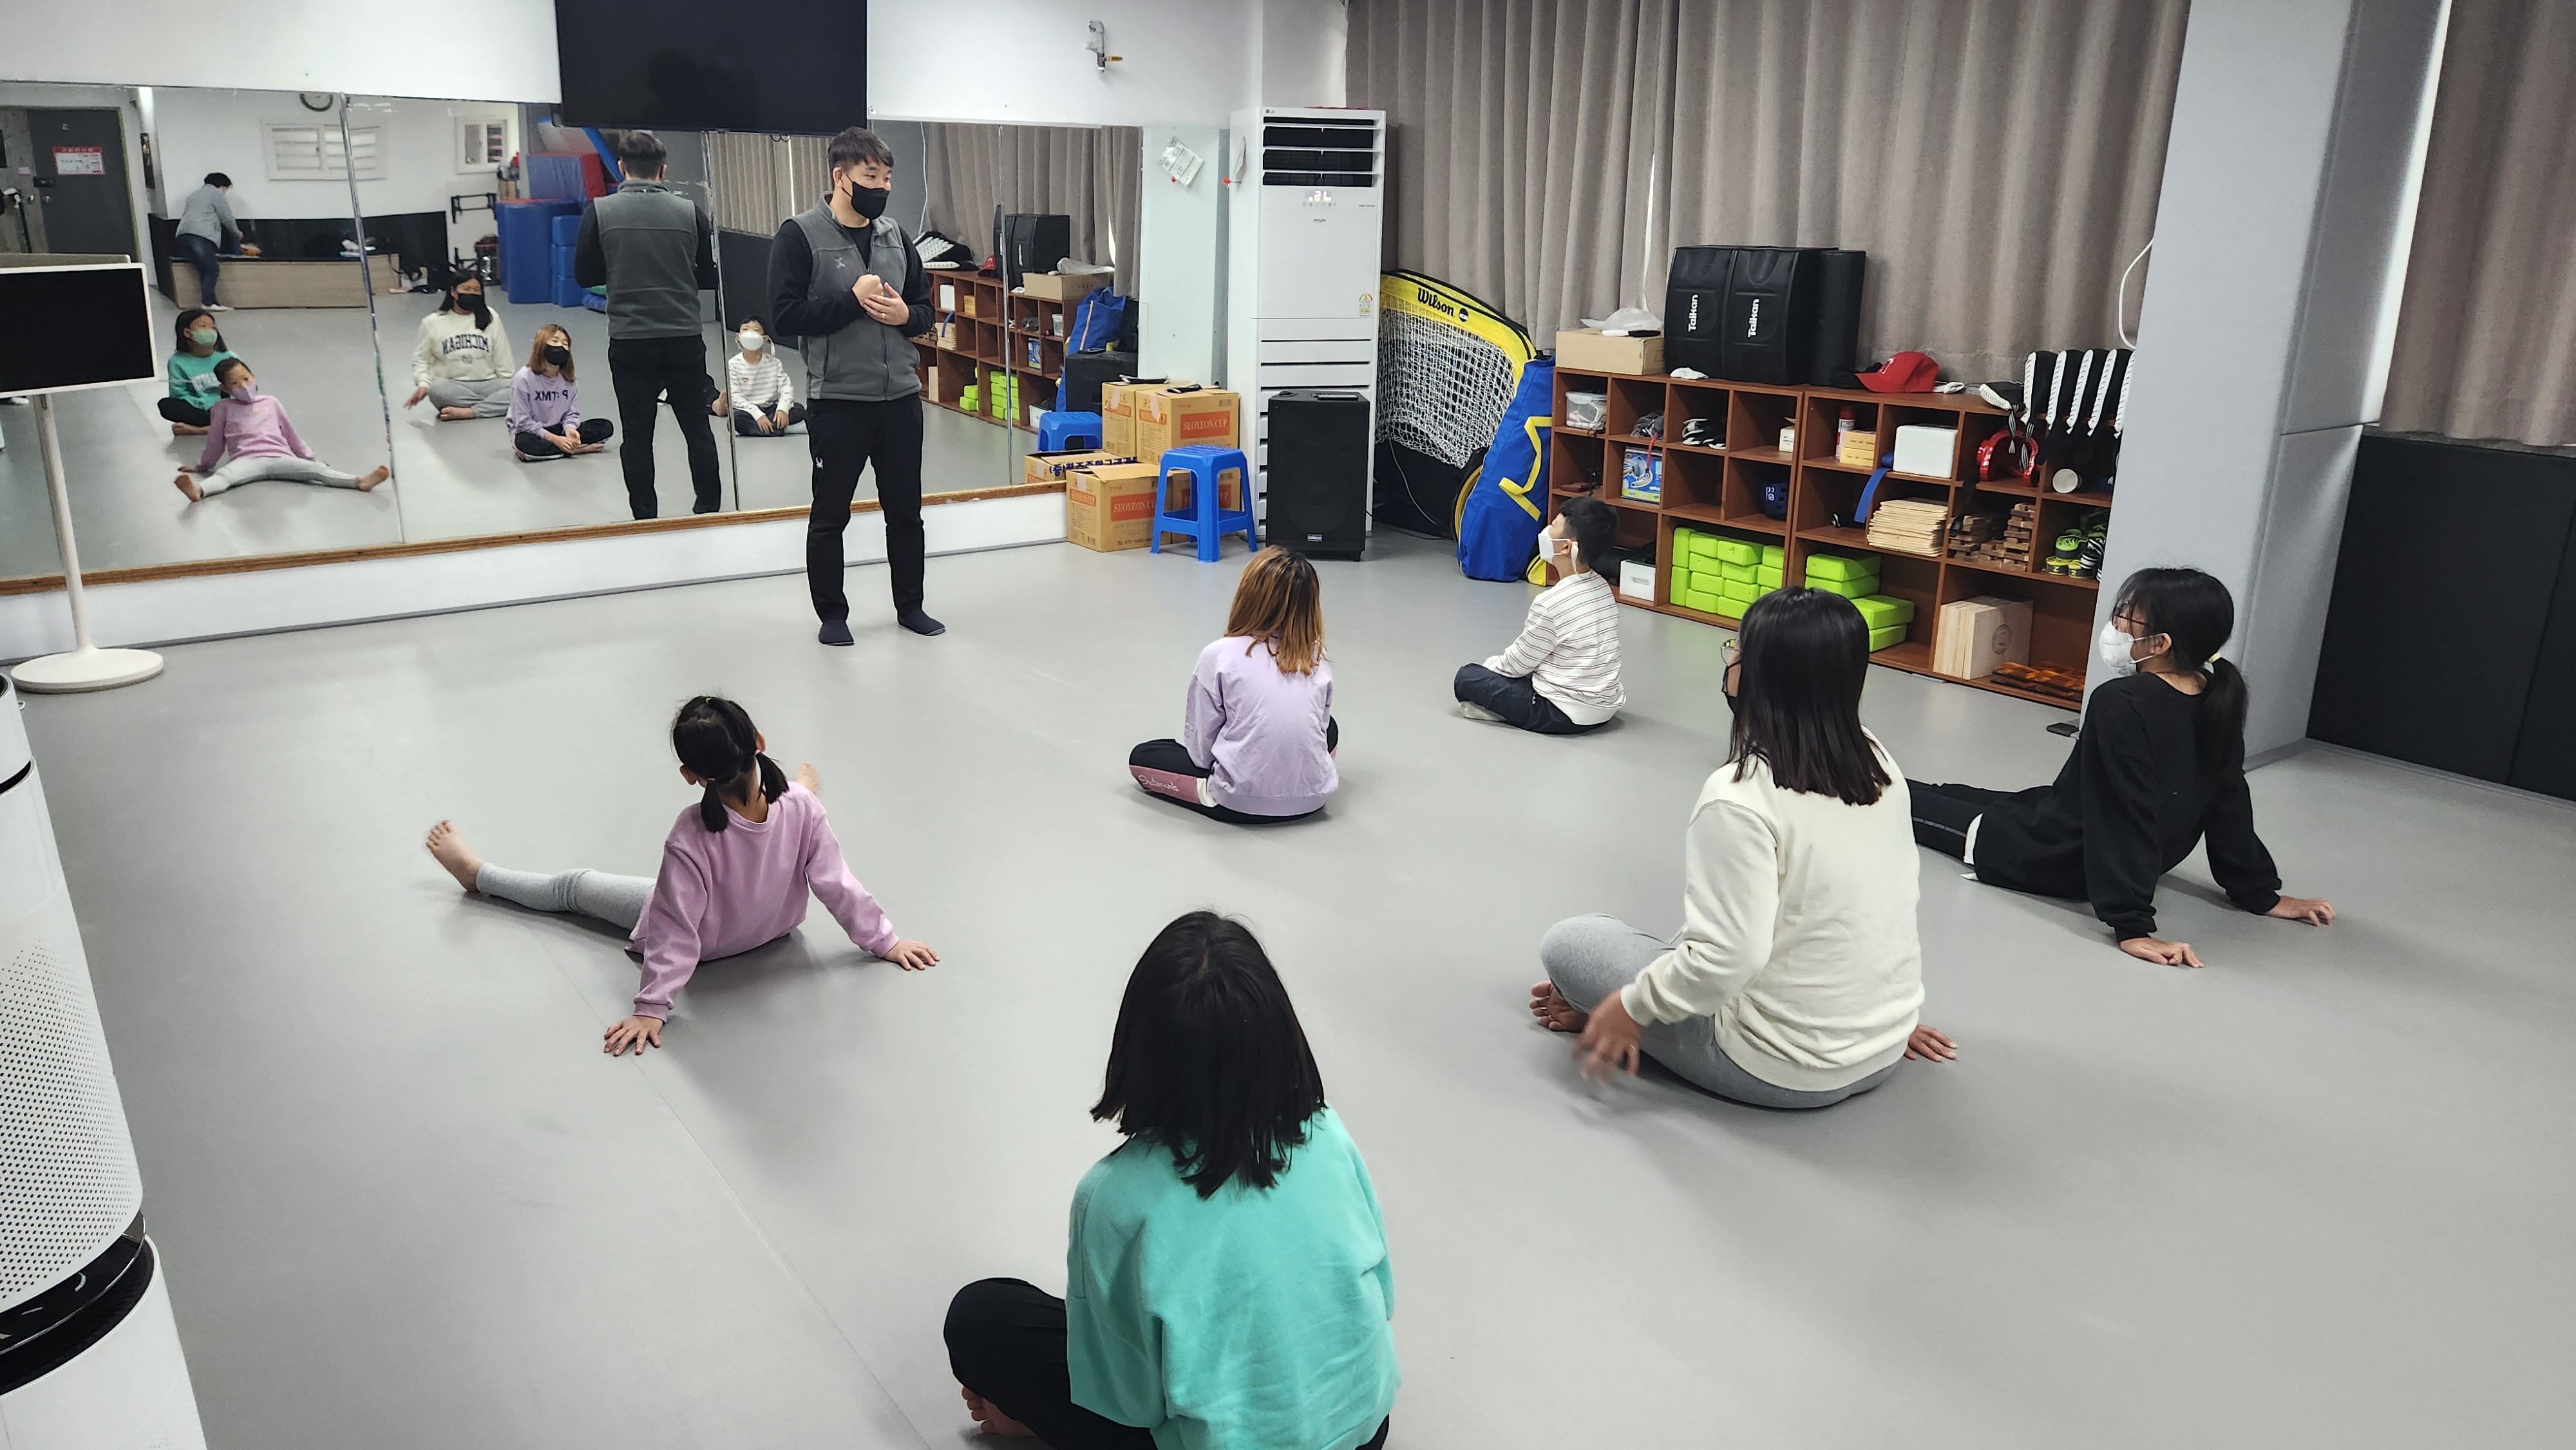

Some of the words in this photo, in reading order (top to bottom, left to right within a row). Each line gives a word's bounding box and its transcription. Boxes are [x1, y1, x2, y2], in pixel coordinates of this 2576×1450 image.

[1418, 287, 1454, 317] Wilson
[1183, 419, 1215, 431] SEOYEON
[1215, 418, 1227, 428] CUP
[1113, 500, 1146, 513] SEOYEON
